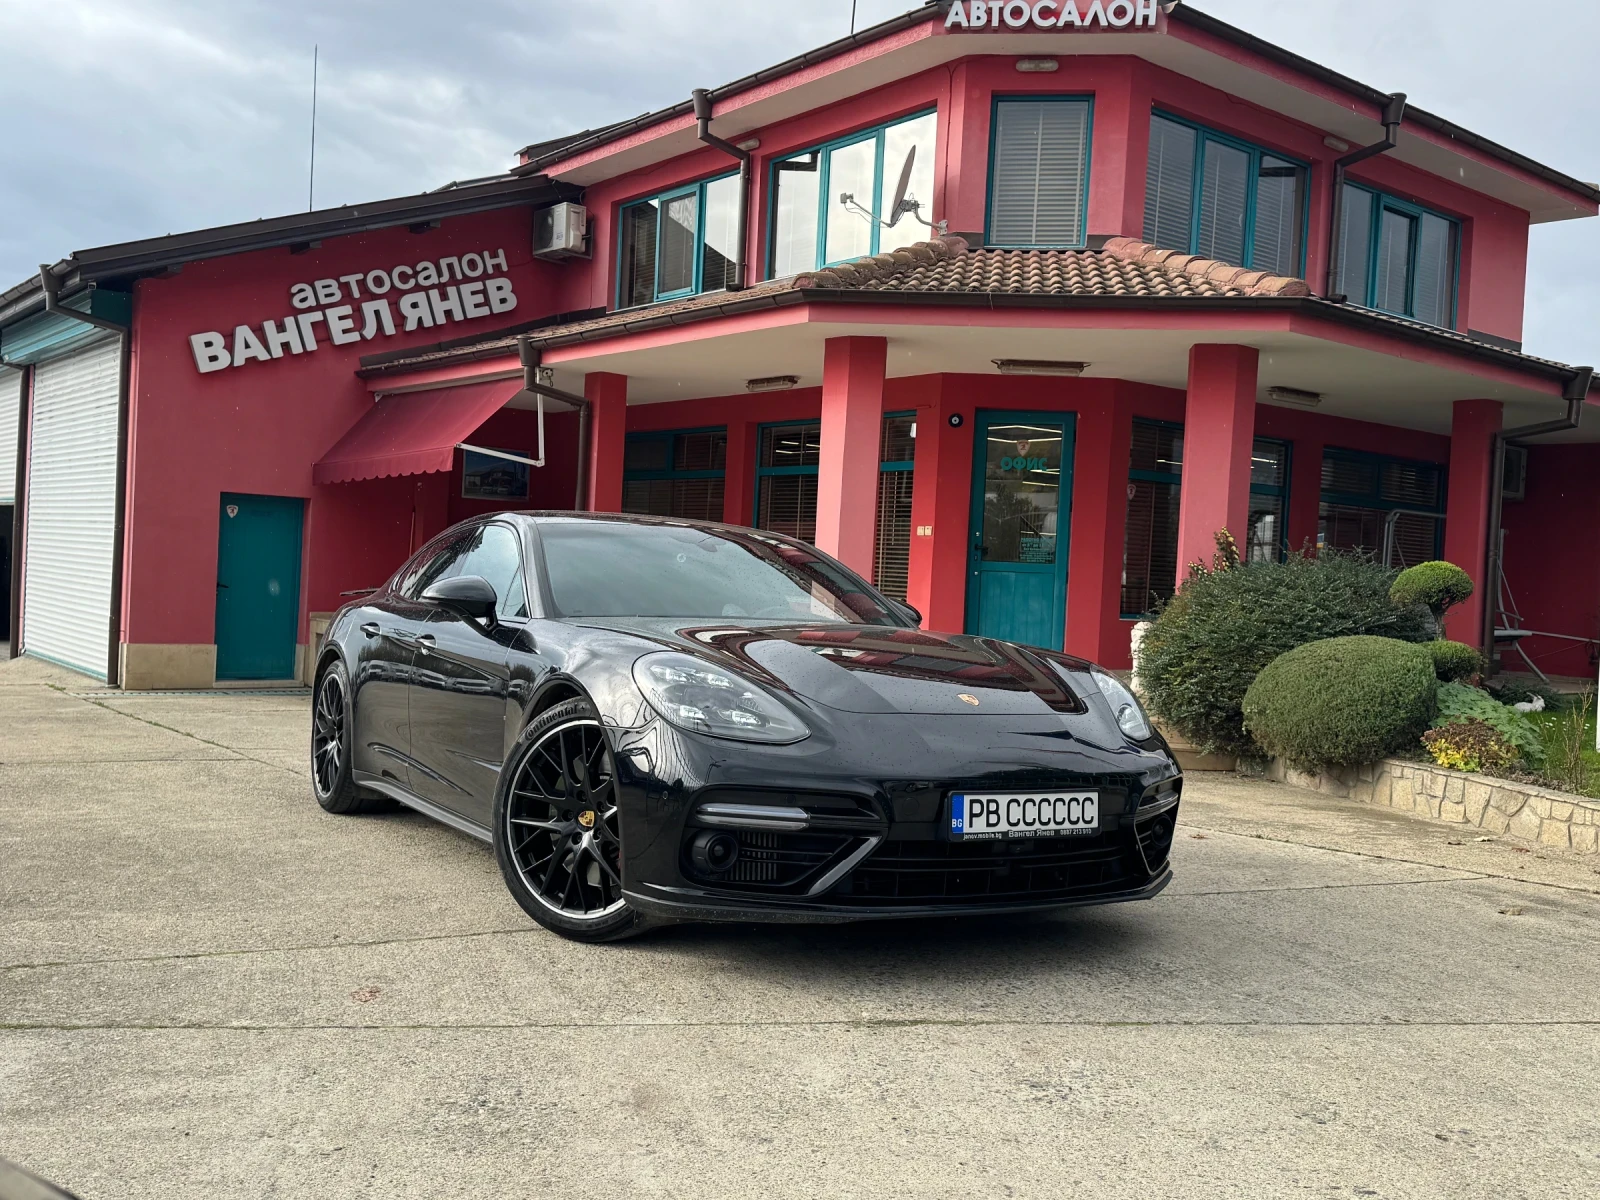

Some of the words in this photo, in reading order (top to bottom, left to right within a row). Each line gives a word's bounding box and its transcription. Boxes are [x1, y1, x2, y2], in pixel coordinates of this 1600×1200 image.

[944, 0, 1157, 29] АВТОСАЛОН
[290, 248, 509, 308] автосалон
[188, 298, 396, 374] ВАНГЕЛ
[398, 277, 518, 332] ЯНЕВ
[1001, 456, 1047, 472] ОФИС
[525, 703, 578, 741] Continental
[952, 818, 963, 828] BG
[968, 798, 1001, 828] PB
[1006, 796, 1095, 827] CCCCCC
[1008, 830, 1034, 838] Вангел
